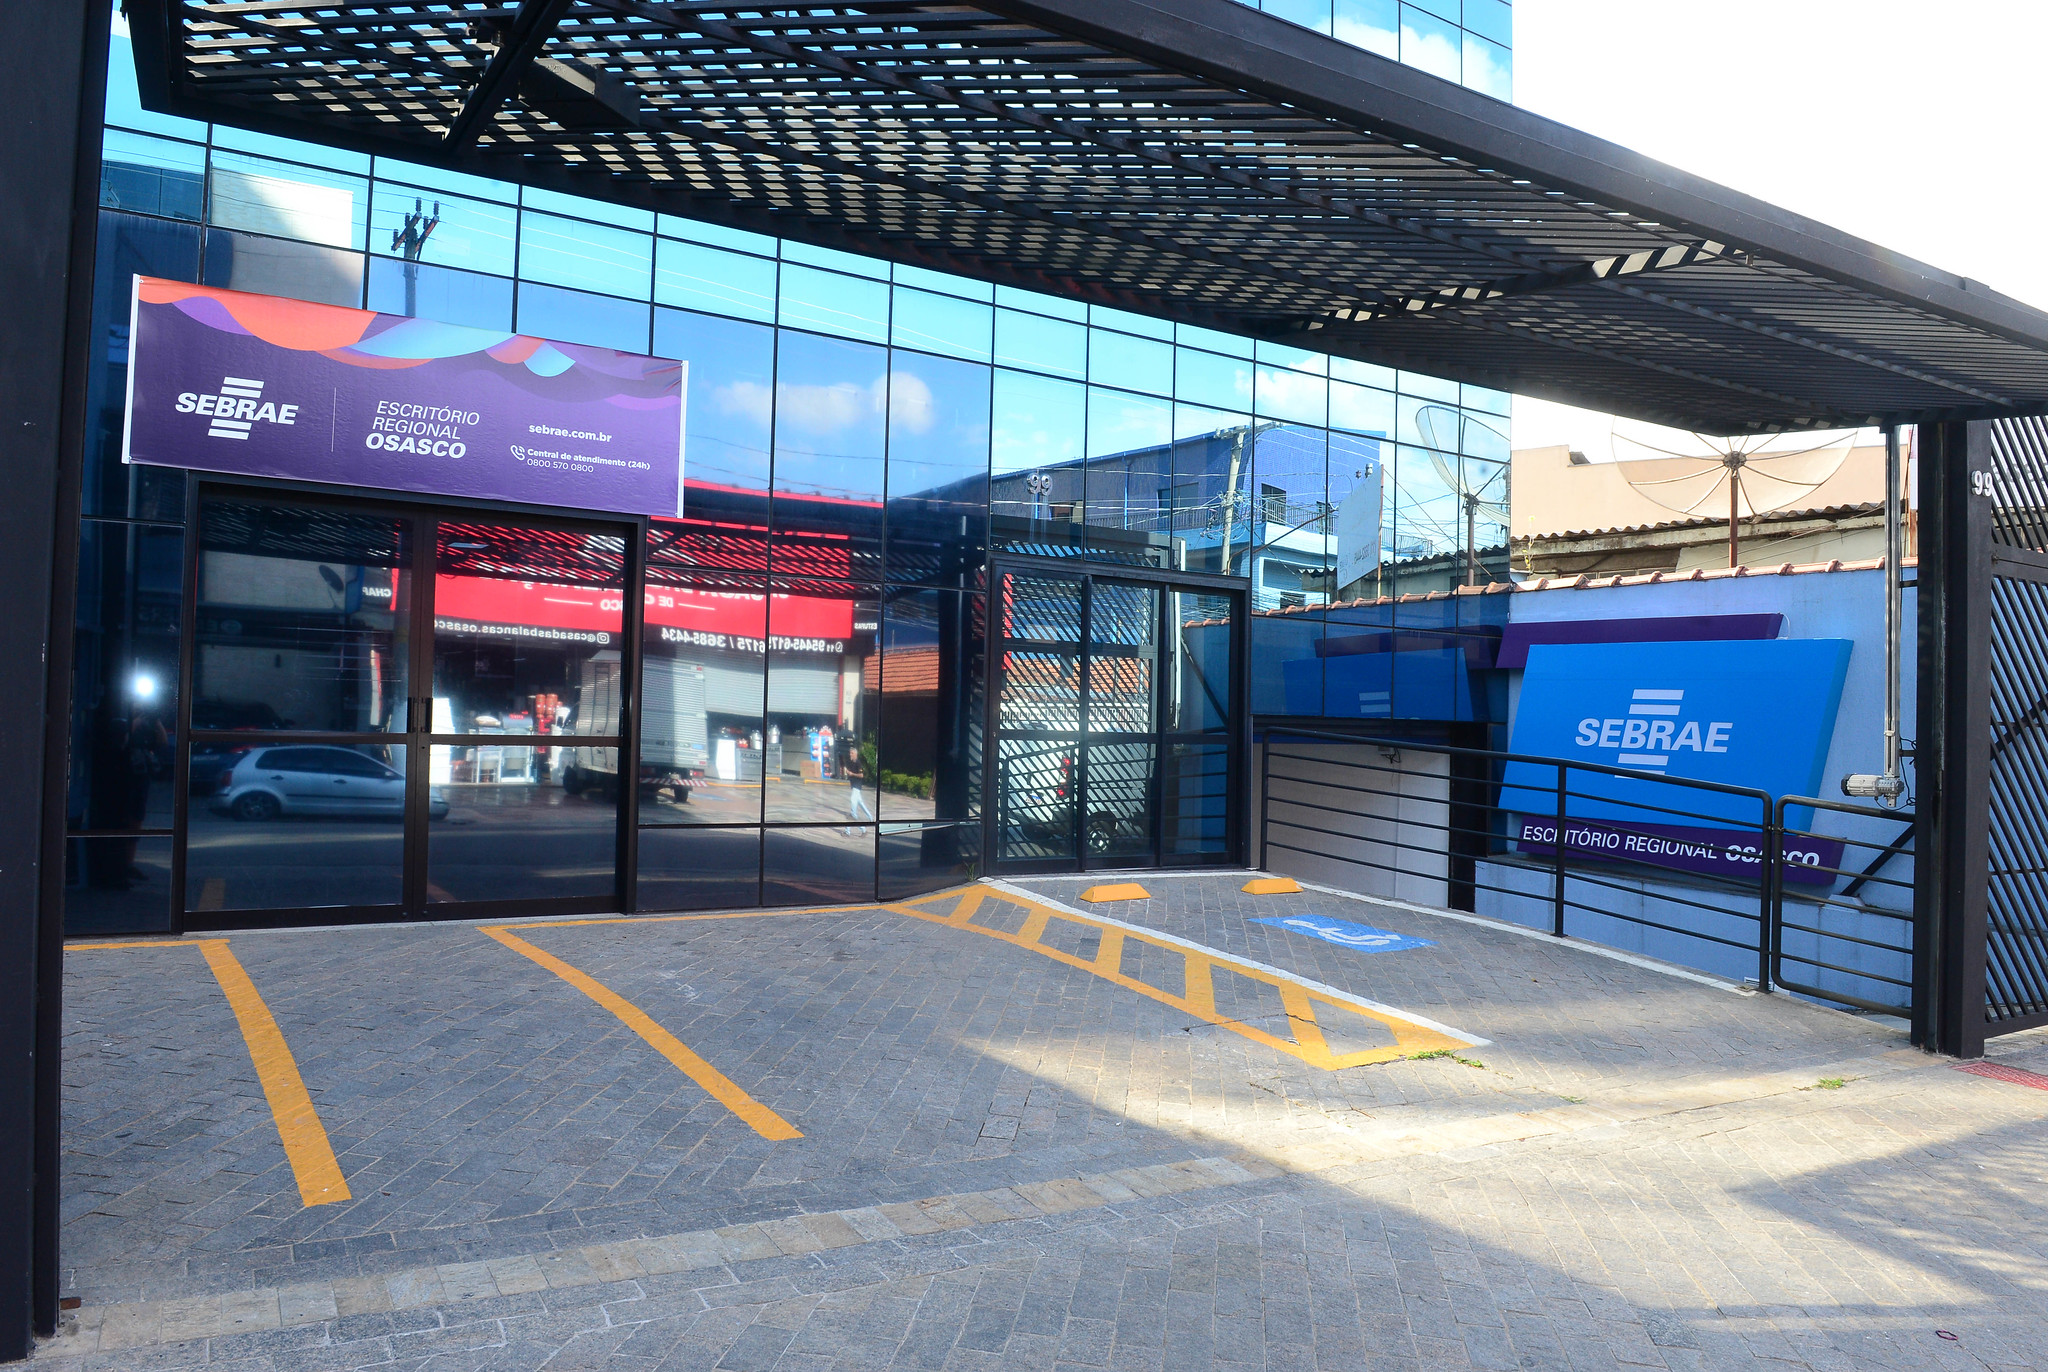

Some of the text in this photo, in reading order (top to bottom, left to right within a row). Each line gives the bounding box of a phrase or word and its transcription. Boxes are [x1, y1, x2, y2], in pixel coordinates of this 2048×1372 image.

[175, 392, 299, 425] SEBRAE
[376, 400, 480, 426] ESCRITÓRIO
[372, 416, 461, 440] REGIONAL
[528, 425, 612, 442] sebrae.com.br
[365, 432, 467, 459] OSASCO
[527, 448, 651, 471] Central de atendimento (24h)
[527, 458, 594, 473] 0800 570 0800
[1971, 470, 1993, 497] 99
[1575, 718, 1733, 753] SEBRAE
[1624, 835, 1718, 860] REGIONAL
